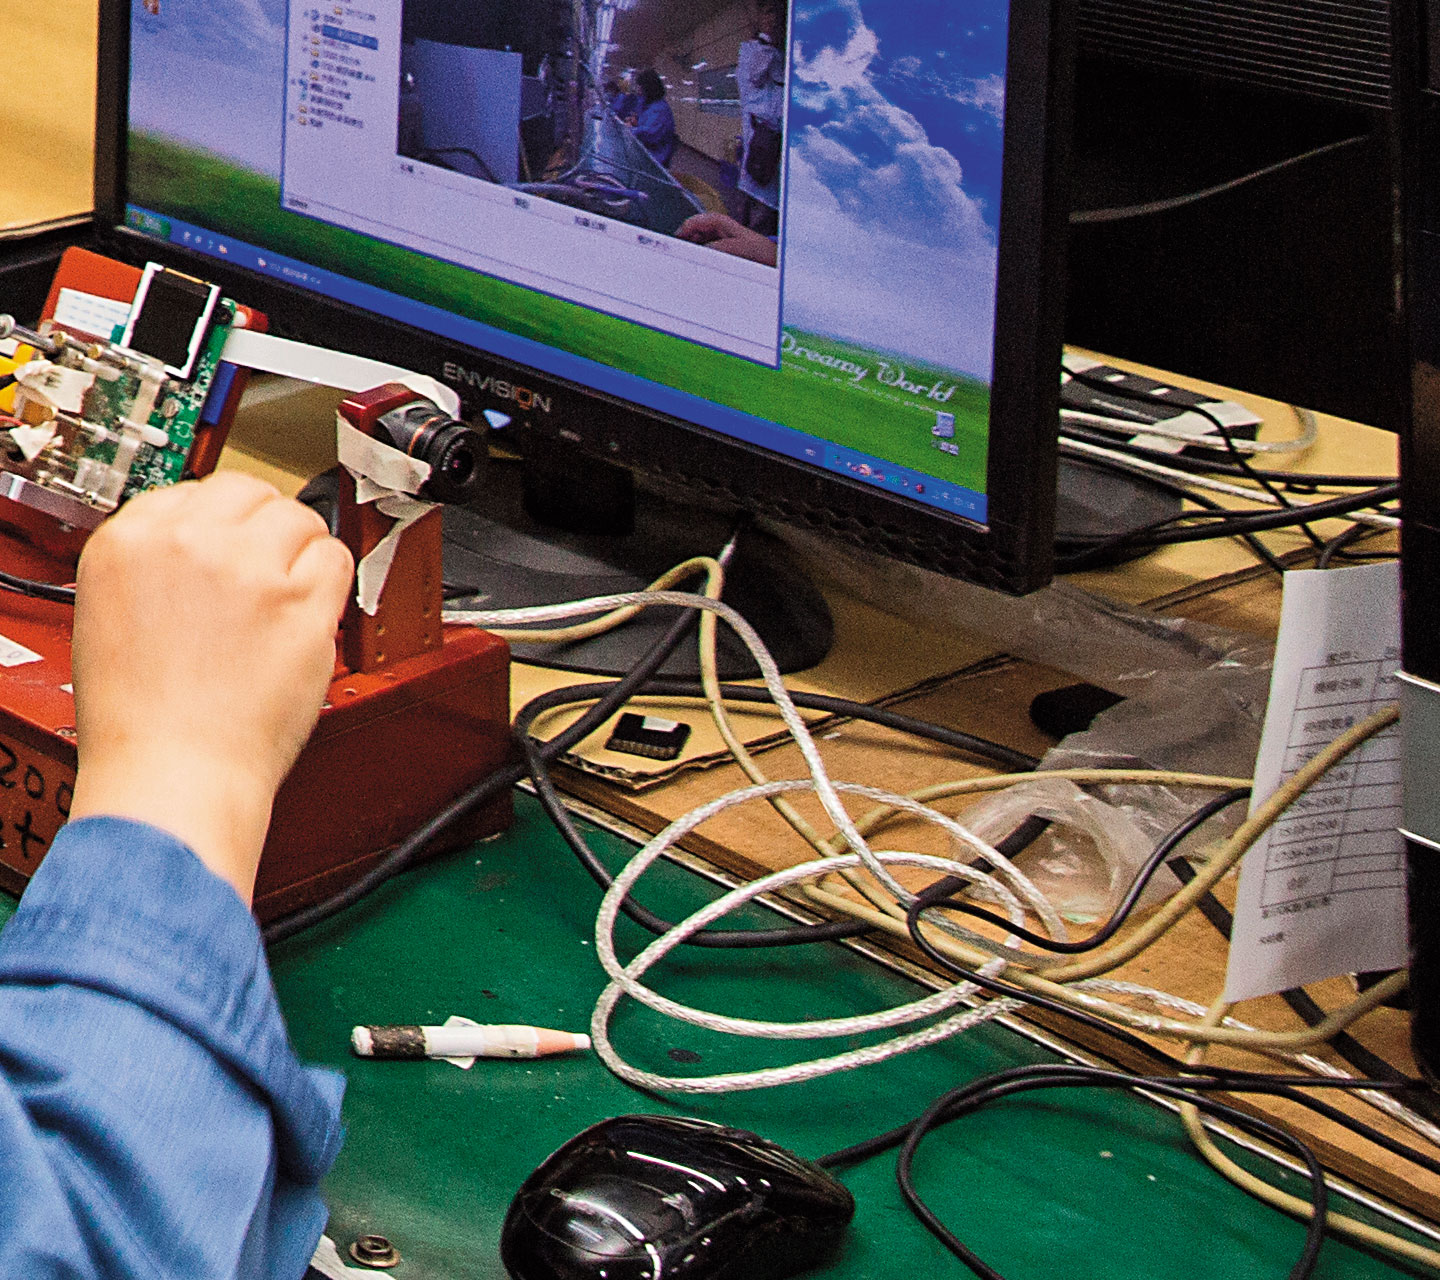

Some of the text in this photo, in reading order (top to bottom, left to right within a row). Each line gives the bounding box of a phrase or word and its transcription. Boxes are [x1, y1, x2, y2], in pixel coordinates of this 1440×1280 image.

[442, 361, 553, 414] ENVISION
[782, 329, 869, 383] Dreamy
[877, 361, 958, 403] World
